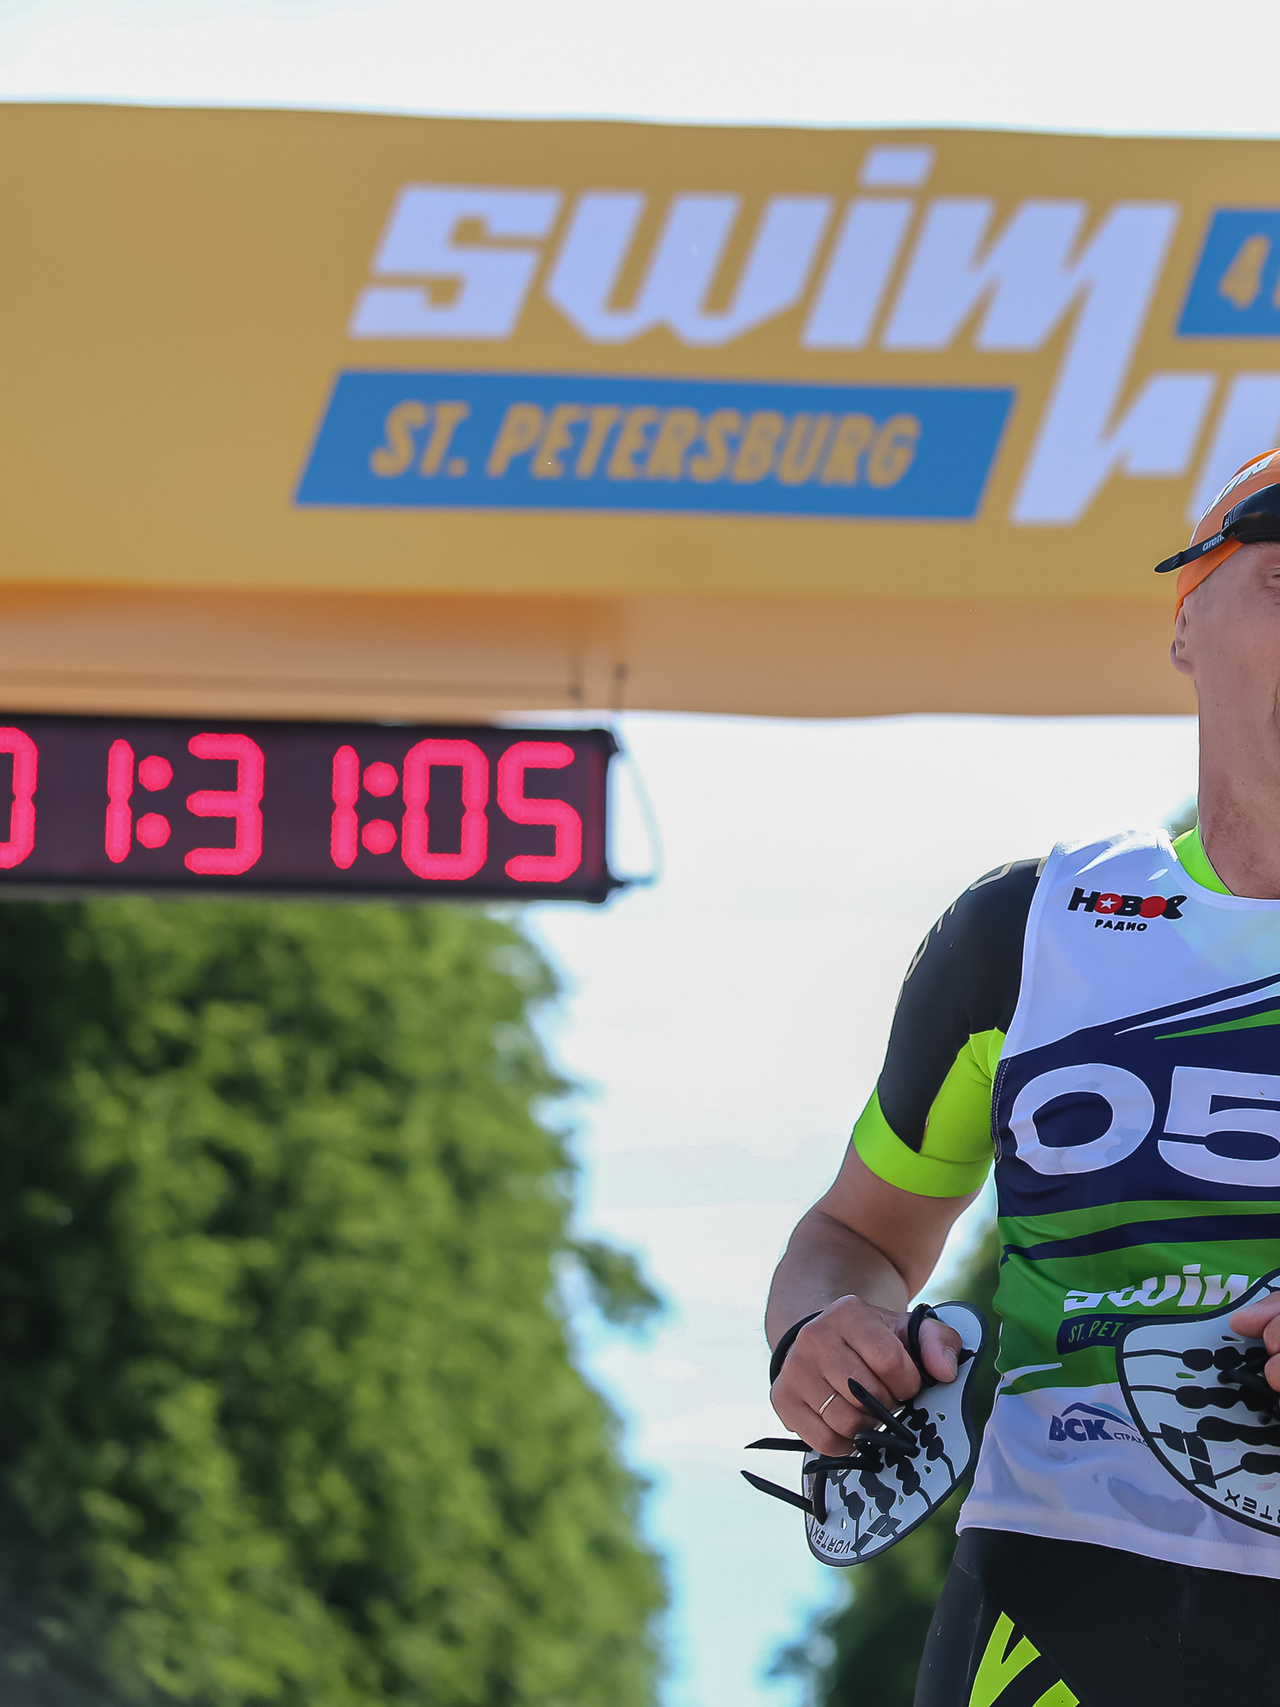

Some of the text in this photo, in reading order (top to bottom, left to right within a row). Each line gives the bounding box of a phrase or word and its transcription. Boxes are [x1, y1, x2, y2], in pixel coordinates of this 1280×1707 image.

[1219, 235, 1270, 310] 4
[370, 401, 922, 488] ST. PETERSBURG
[1094, 918, 1148, 932] РАДИО
[812, 1525, 851, 1554] VORTEX
